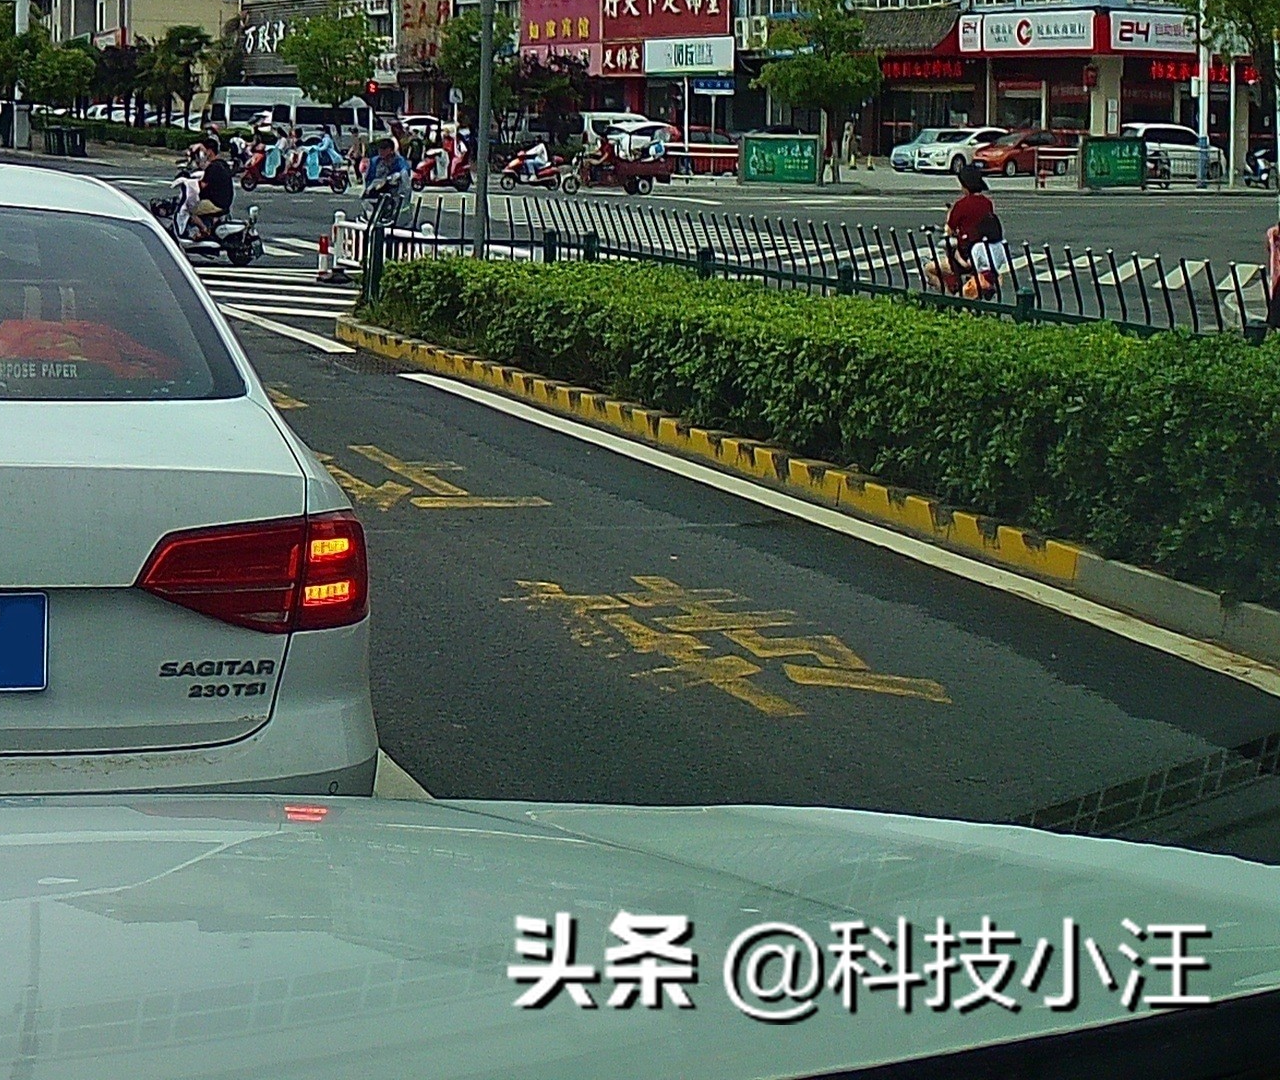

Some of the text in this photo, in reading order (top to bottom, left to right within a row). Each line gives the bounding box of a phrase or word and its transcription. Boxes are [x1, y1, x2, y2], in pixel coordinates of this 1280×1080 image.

[1119, 21, 1150, 43] 24
[602, 46, 640, 70] 足锦堂
[41, 363, 78, 378] PAPER
[159, 660, 276, 677] SAGITAR
[188, 682, 267, 698] 230 TSI
